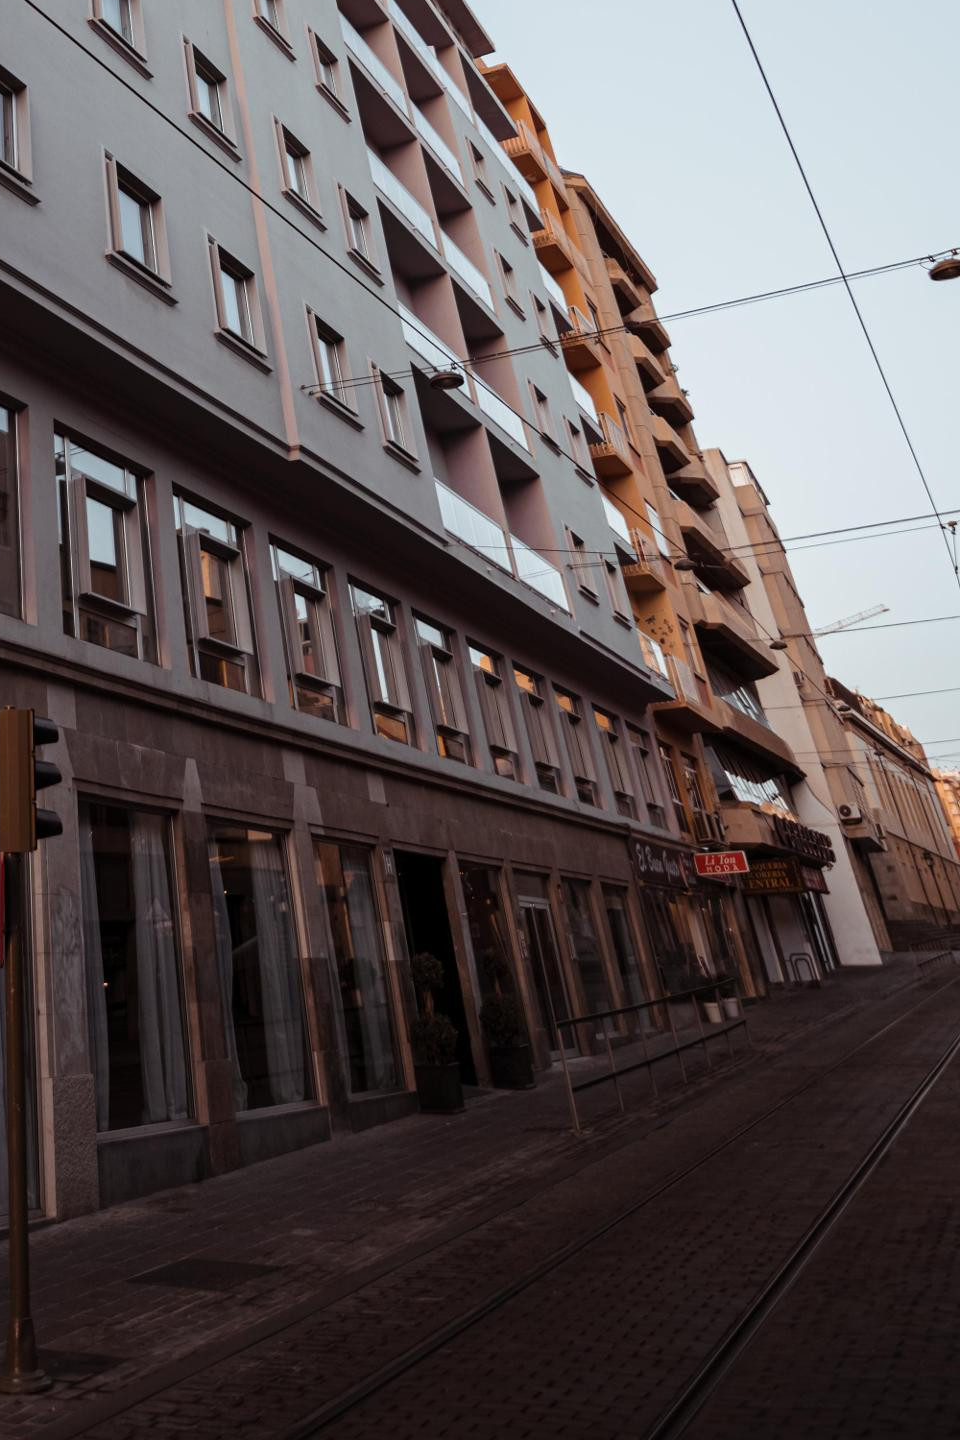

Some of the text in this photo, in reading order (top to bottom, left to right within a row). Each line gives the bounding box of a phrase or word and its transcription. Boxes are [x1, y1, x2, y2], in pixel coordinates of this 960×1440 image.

[704, 854, 736, 865] Li Ton
[705, 863, 739, 872] MODA
